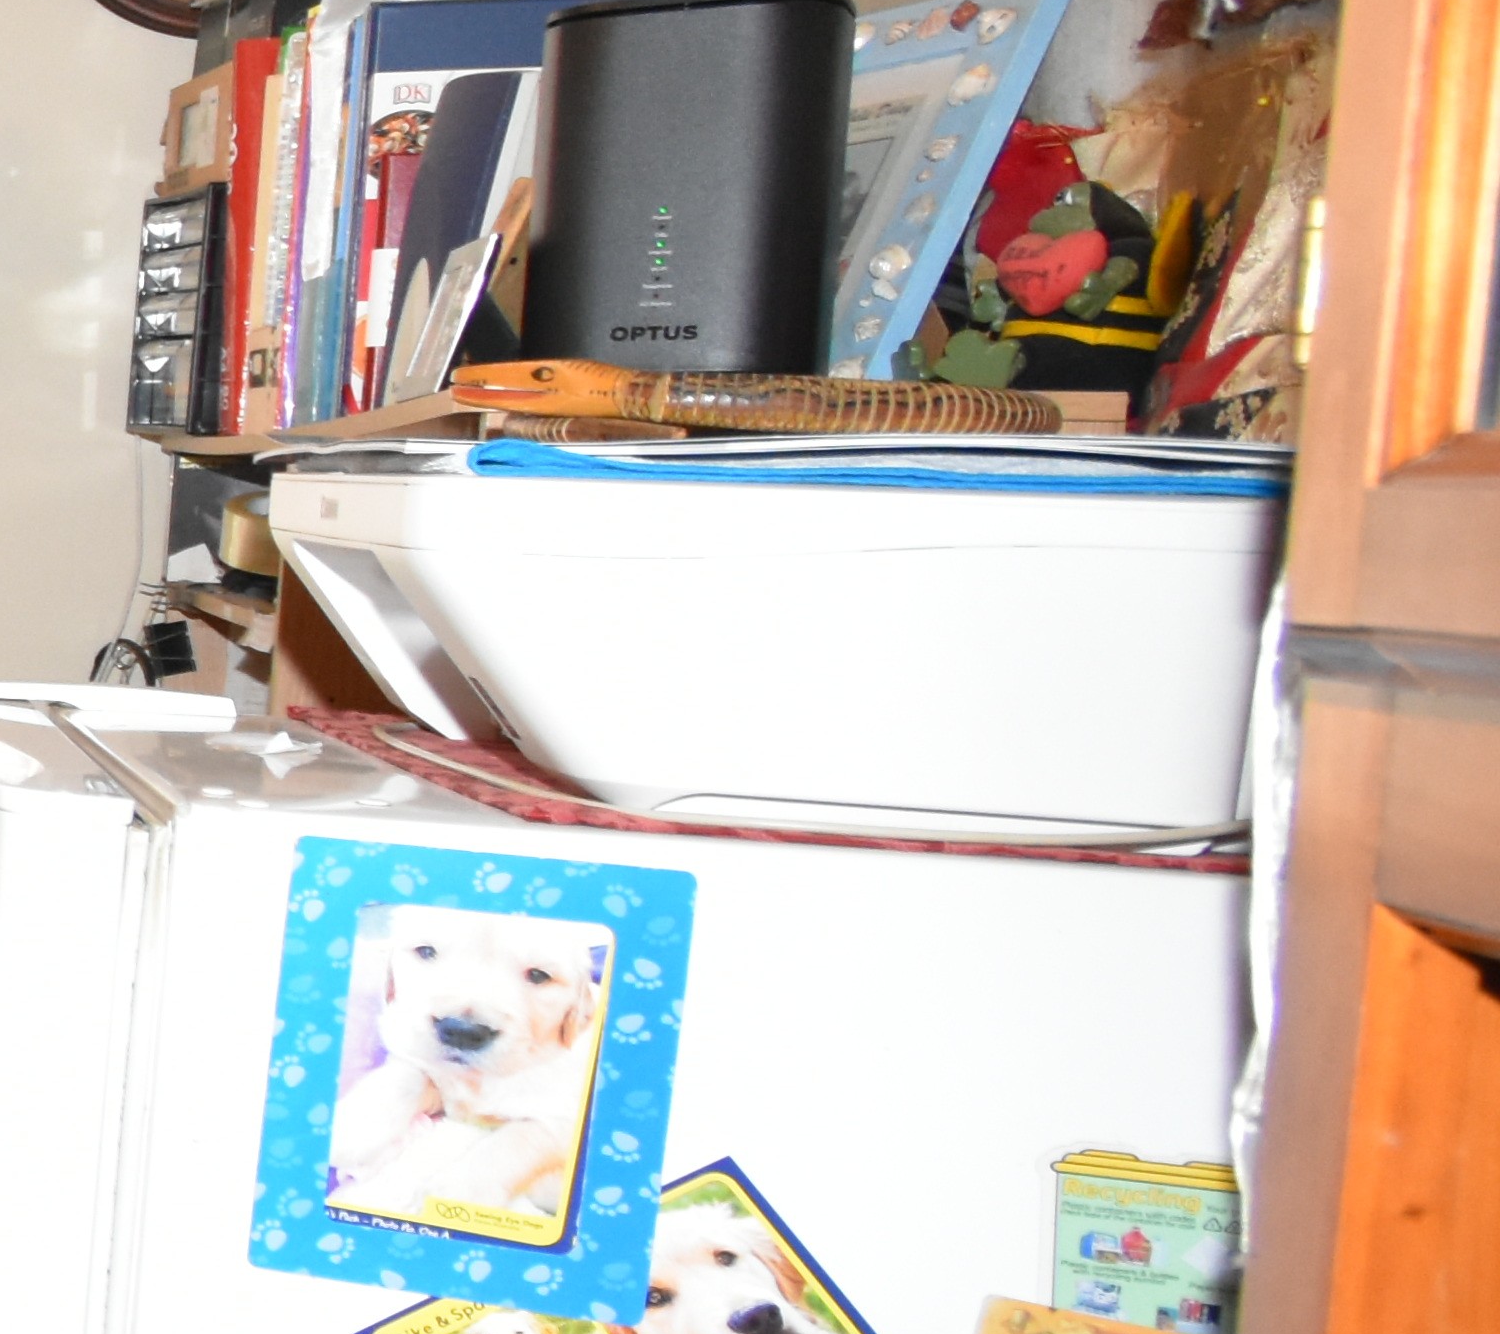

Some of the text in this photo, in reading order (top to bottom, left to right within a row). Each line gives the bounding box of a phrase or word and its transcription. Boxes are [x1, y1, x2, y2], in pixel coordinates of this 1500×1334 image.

[395, 84, 429, 103] DK
[609, 324, 698, 342] OPTUS
[1063, 1177, 1202, 1215] Recycling
[435, 1315, 450, 1329] &
